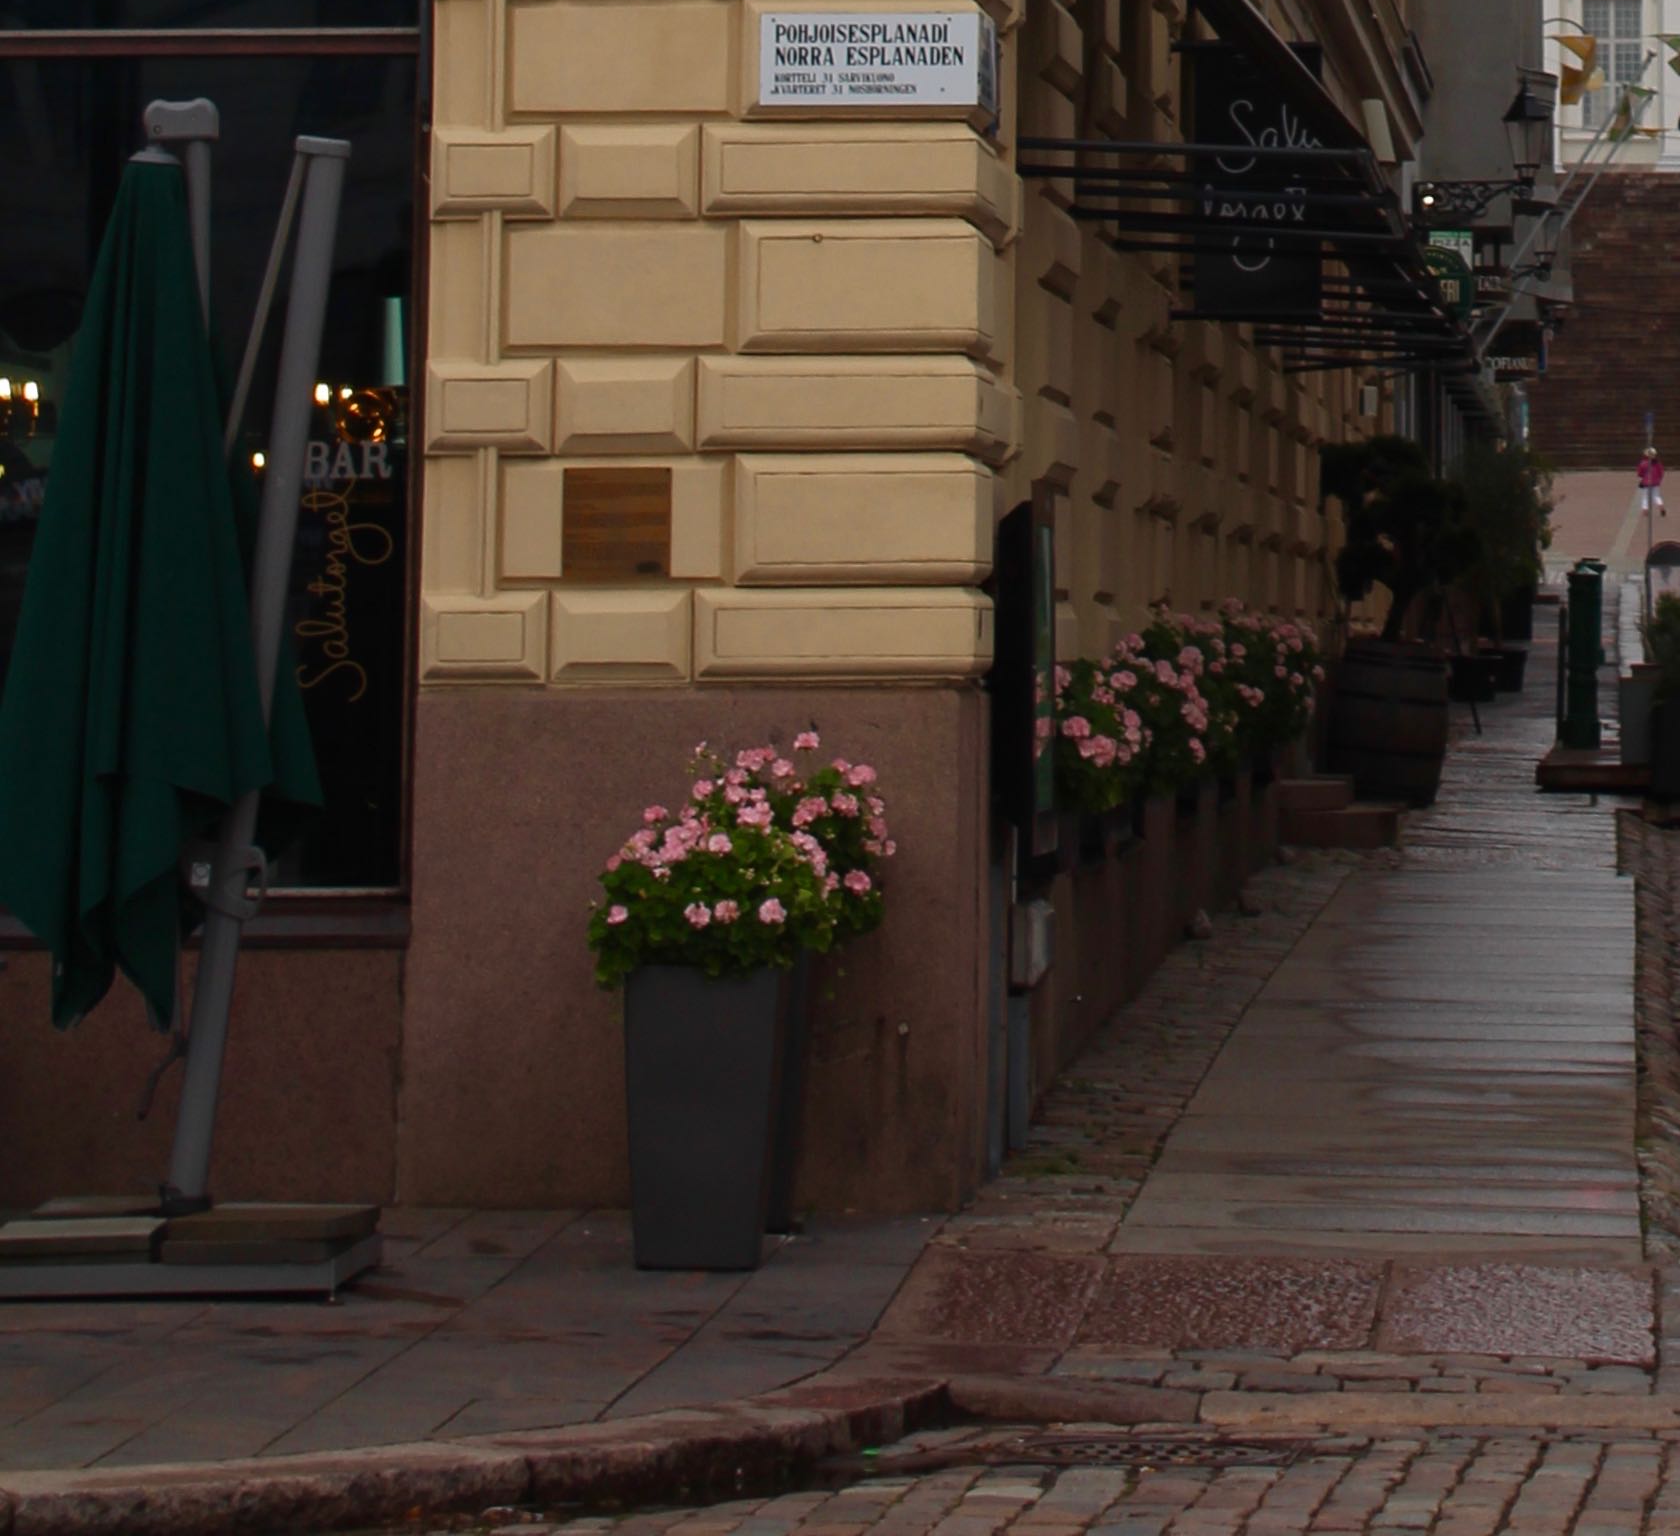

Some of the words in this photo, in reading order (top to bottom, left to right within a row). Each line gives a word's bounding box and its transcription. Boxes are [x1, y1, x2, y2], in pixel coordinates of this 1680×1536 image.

[774, 24, 949, 44] POHJOISESPLANADI
[774, 46, 835, 66] NORRA
[846, 46, 965, 66] ESPLANADEN
[303, 439, 393, 480] BAR
[294, 476, 396, 705] Salutorget
